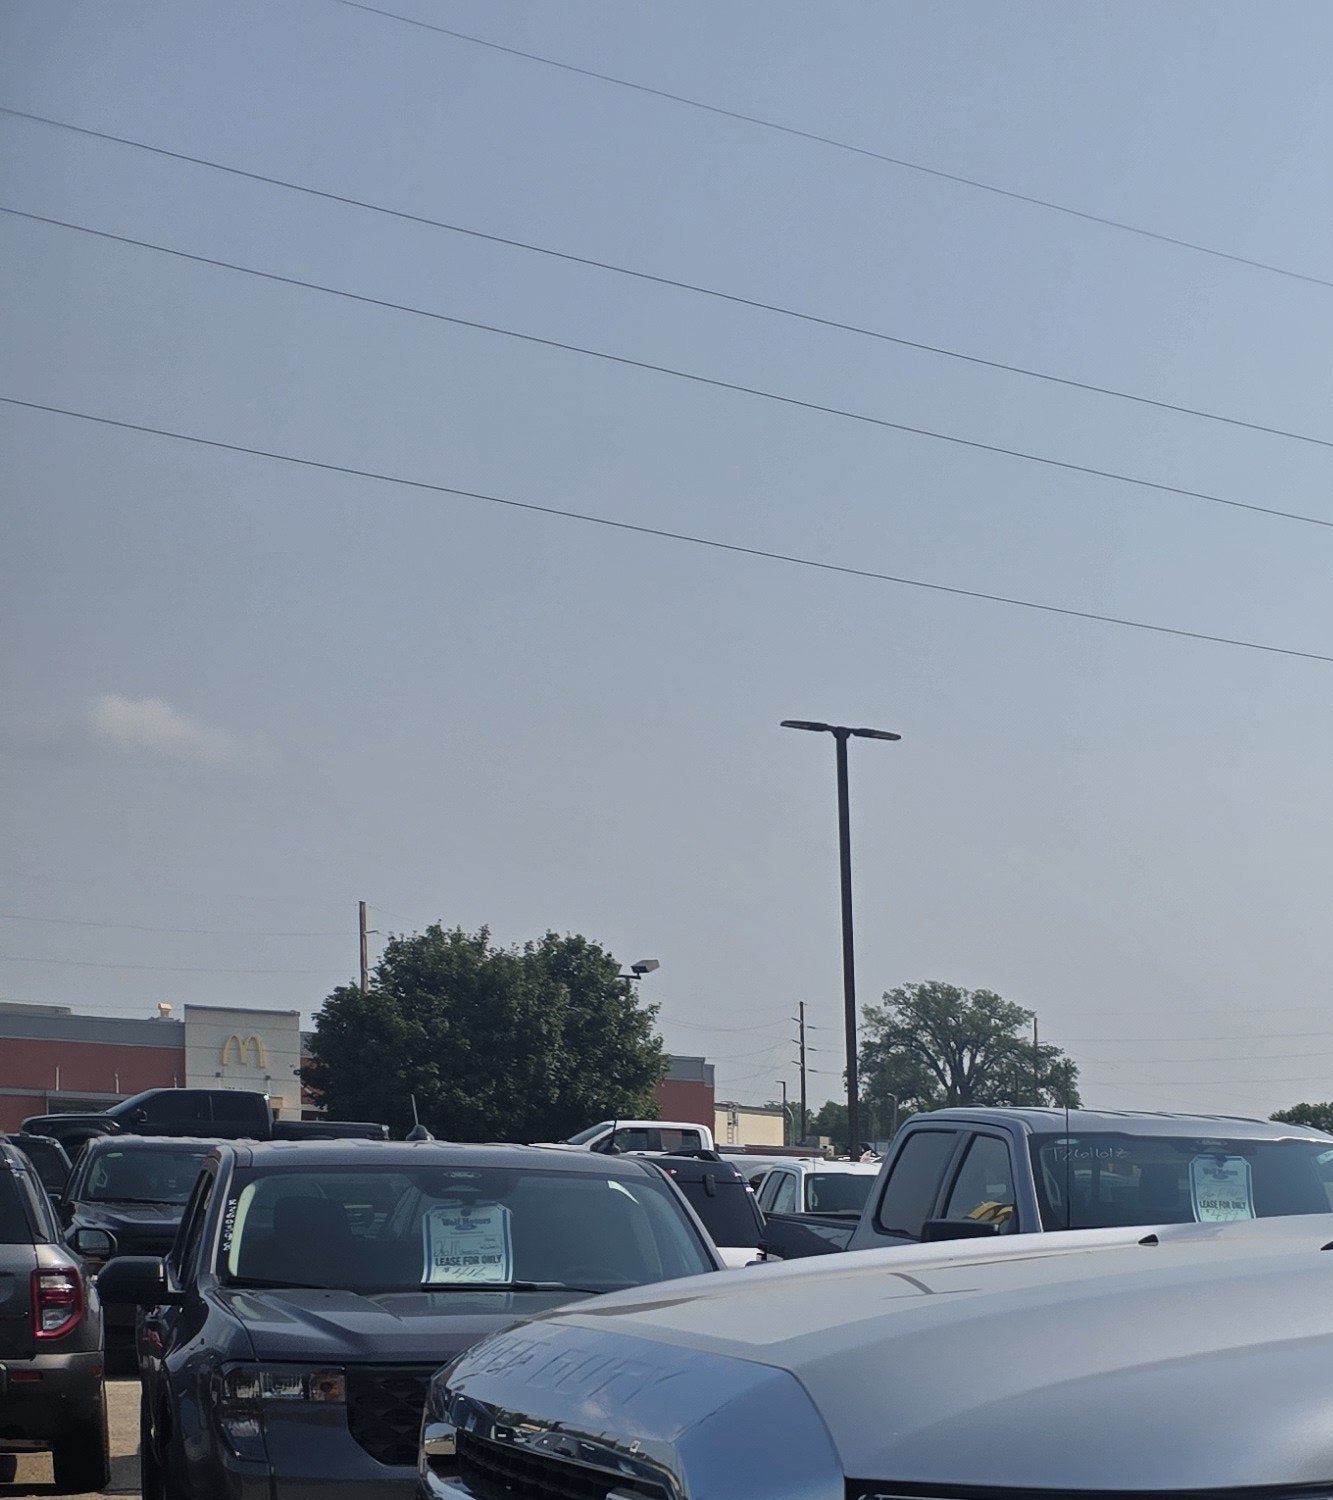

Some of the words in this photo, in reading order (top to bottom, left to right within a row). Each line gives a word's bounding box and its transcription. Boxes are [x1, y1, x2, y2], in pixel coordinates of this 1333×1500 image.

[1200, 1201, 1218, 1209] LEASE
[1219, 1201, 1230, 1209] FOR
[435, 1257, 461, 1267] LEASE
[463, 1256, 480, 1265] FOR
[481, 1254, 502, 1264] ONLY
